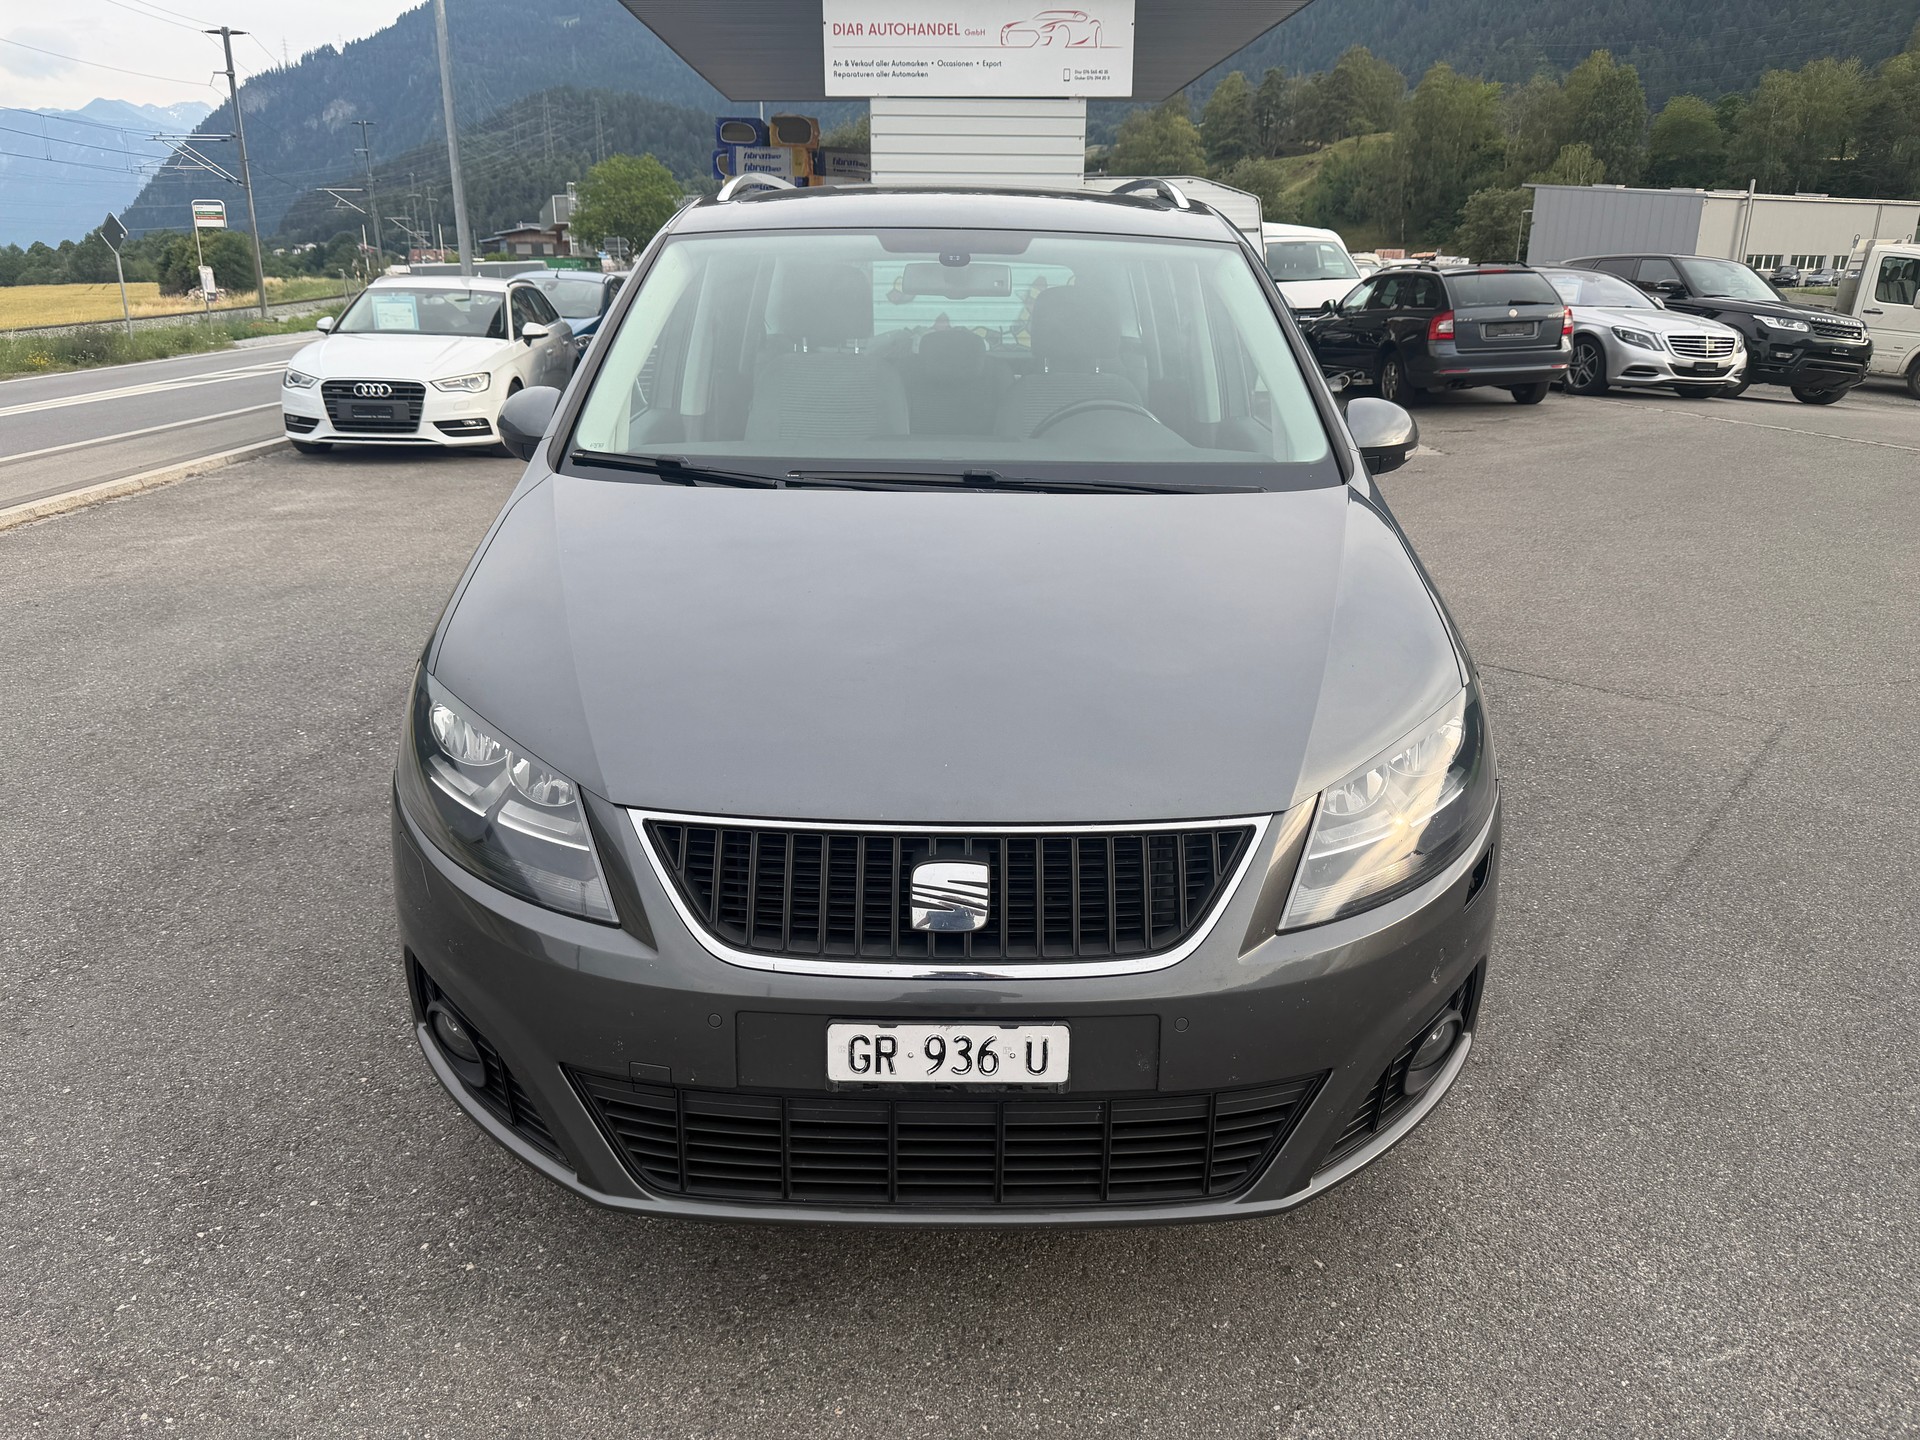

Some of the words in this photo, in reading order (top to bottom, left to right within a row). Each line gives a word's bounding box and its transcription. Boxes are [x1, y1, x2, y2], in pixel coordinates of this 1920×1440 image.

[833, 22, 864, 37] DIAR
[868, 22, 961, 37] AUTOHANDEL
[964, 28, 986, 37] GmbH
[844, 59, 850, 68] &
[850, 59, 875, 68] Verkauf
[875, 59, 890, 68] aller
[891, 59, 929, 68] Automarken
[936, 59, 974, 68] Occasionen
[982, 59, 1002, 69] Export
[833, 69, 875, 80] Reparaturen
[875, 69, 891, 78] aller
[891, 69, 929, 78] Automarken
[848, 1034, 899, 1075] GR
[924, 1034, 1000, 1077] 936
[1025, 1034, 1050, 1076] U
